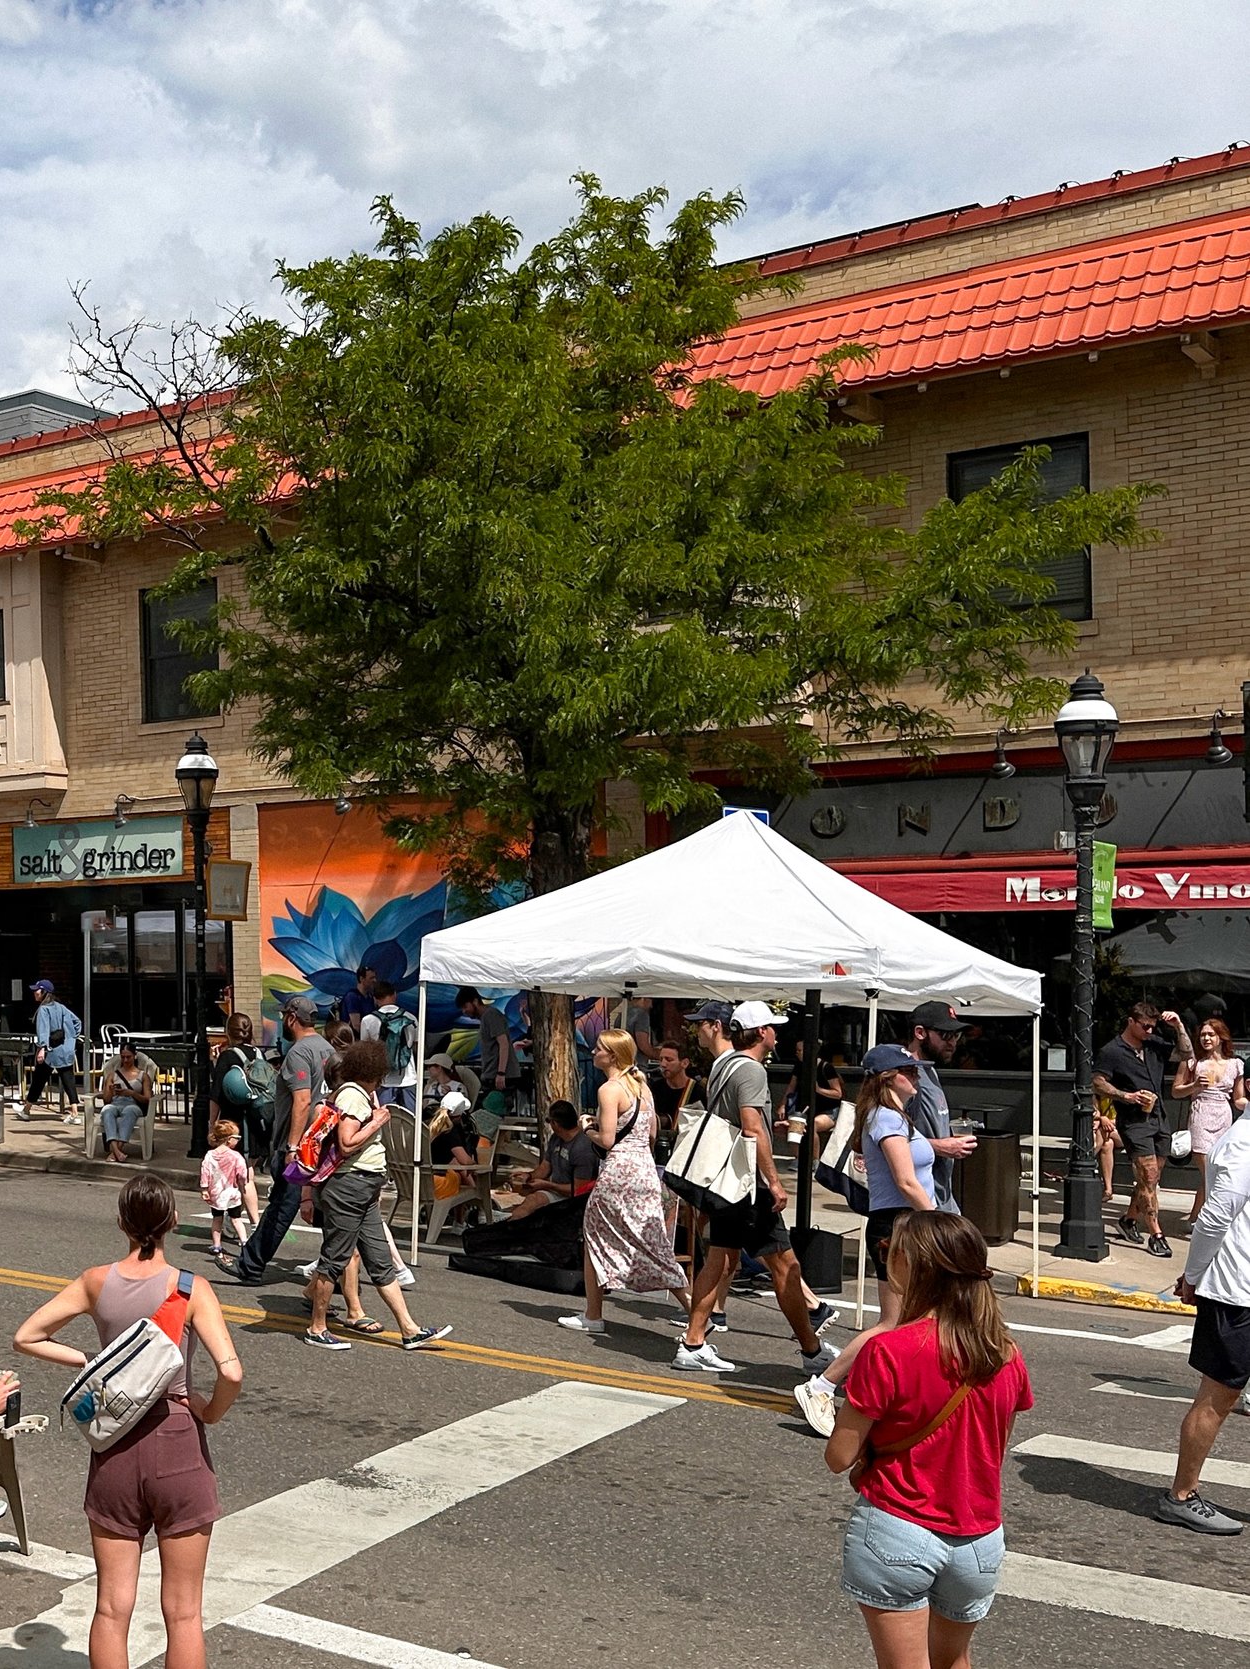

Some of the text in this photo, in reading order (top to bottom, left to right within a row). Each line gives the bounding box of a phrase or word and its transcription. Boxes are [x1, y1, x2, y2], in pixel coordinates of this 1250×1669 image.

[20, 848, 62, 876] salt
[82, 843, 176, 878] grinder
[1006, 872, 1250, 903] Moo Vino
